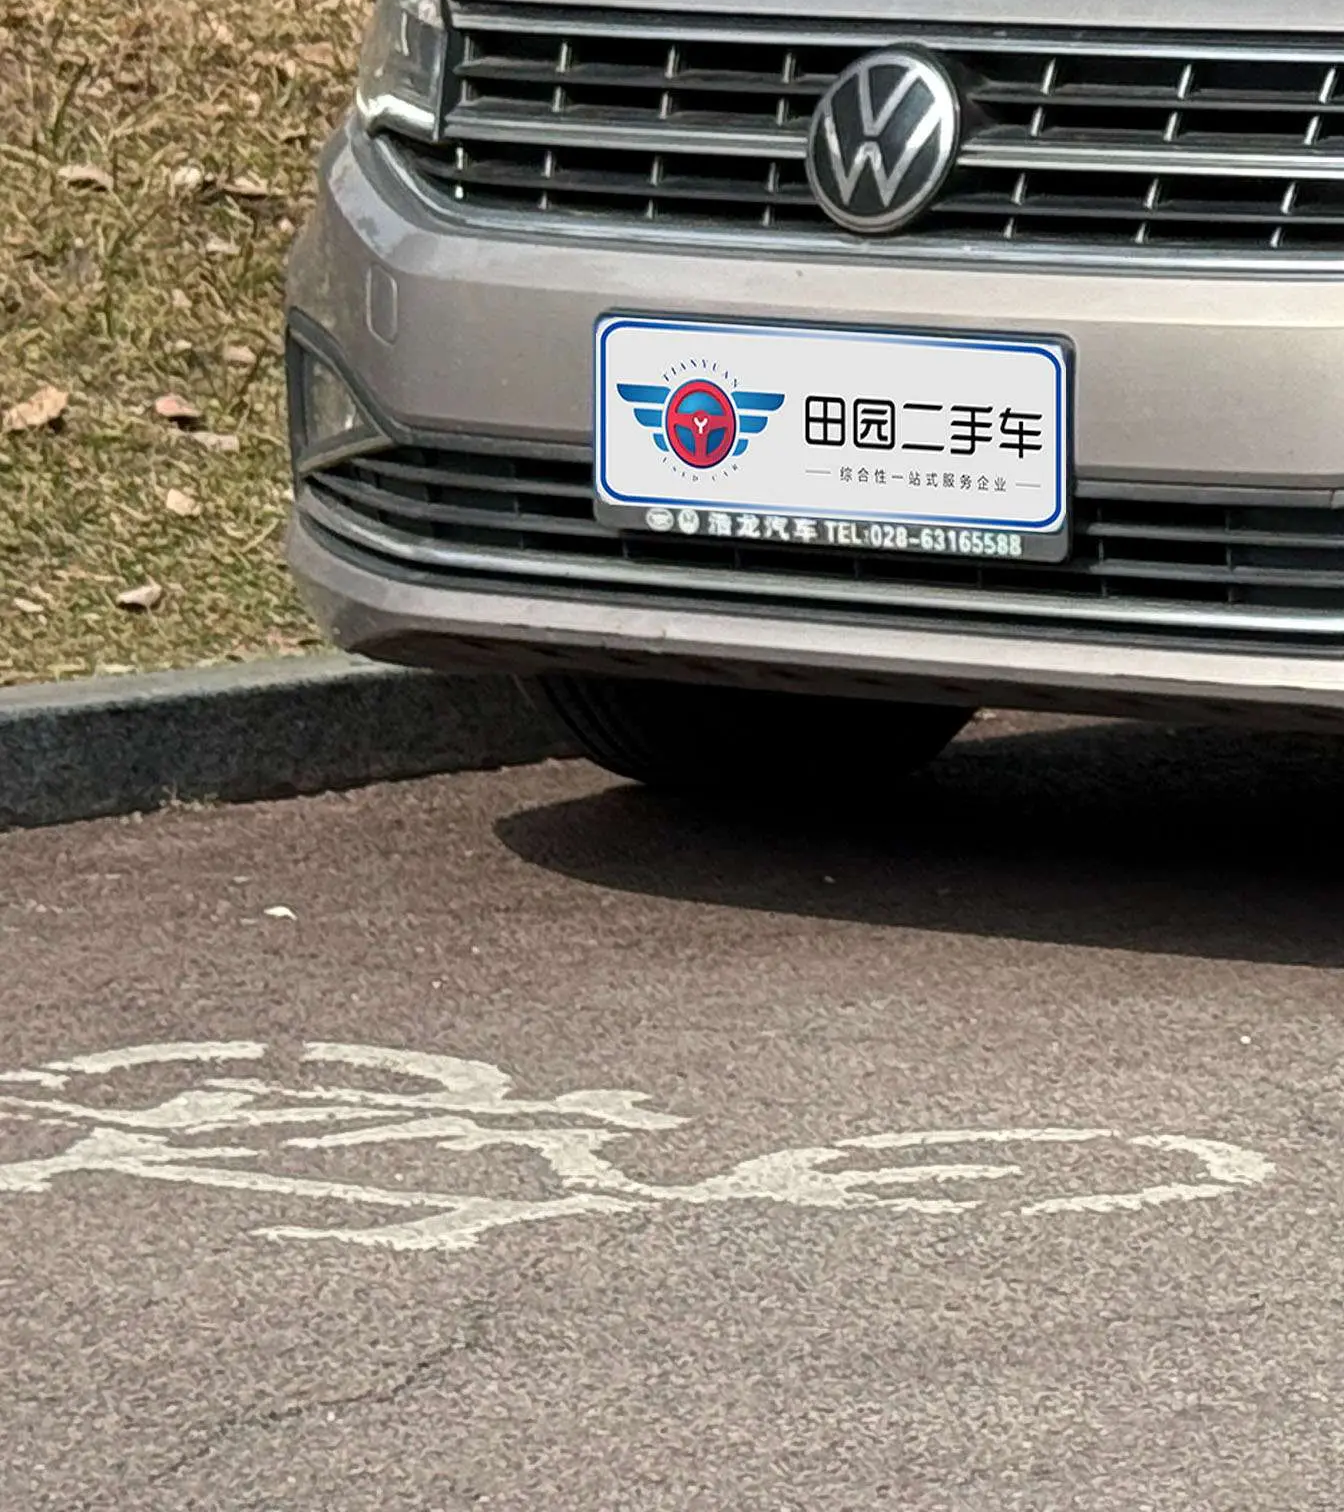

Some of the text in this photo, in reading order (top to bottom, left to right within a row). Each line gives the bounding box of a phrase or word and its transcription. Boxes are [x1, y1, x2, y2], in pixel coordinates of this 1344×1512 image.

[804, 394, 1043, 459] 田园二手车
[839, 466, 1007, 492] 综合性一站式服务企业
